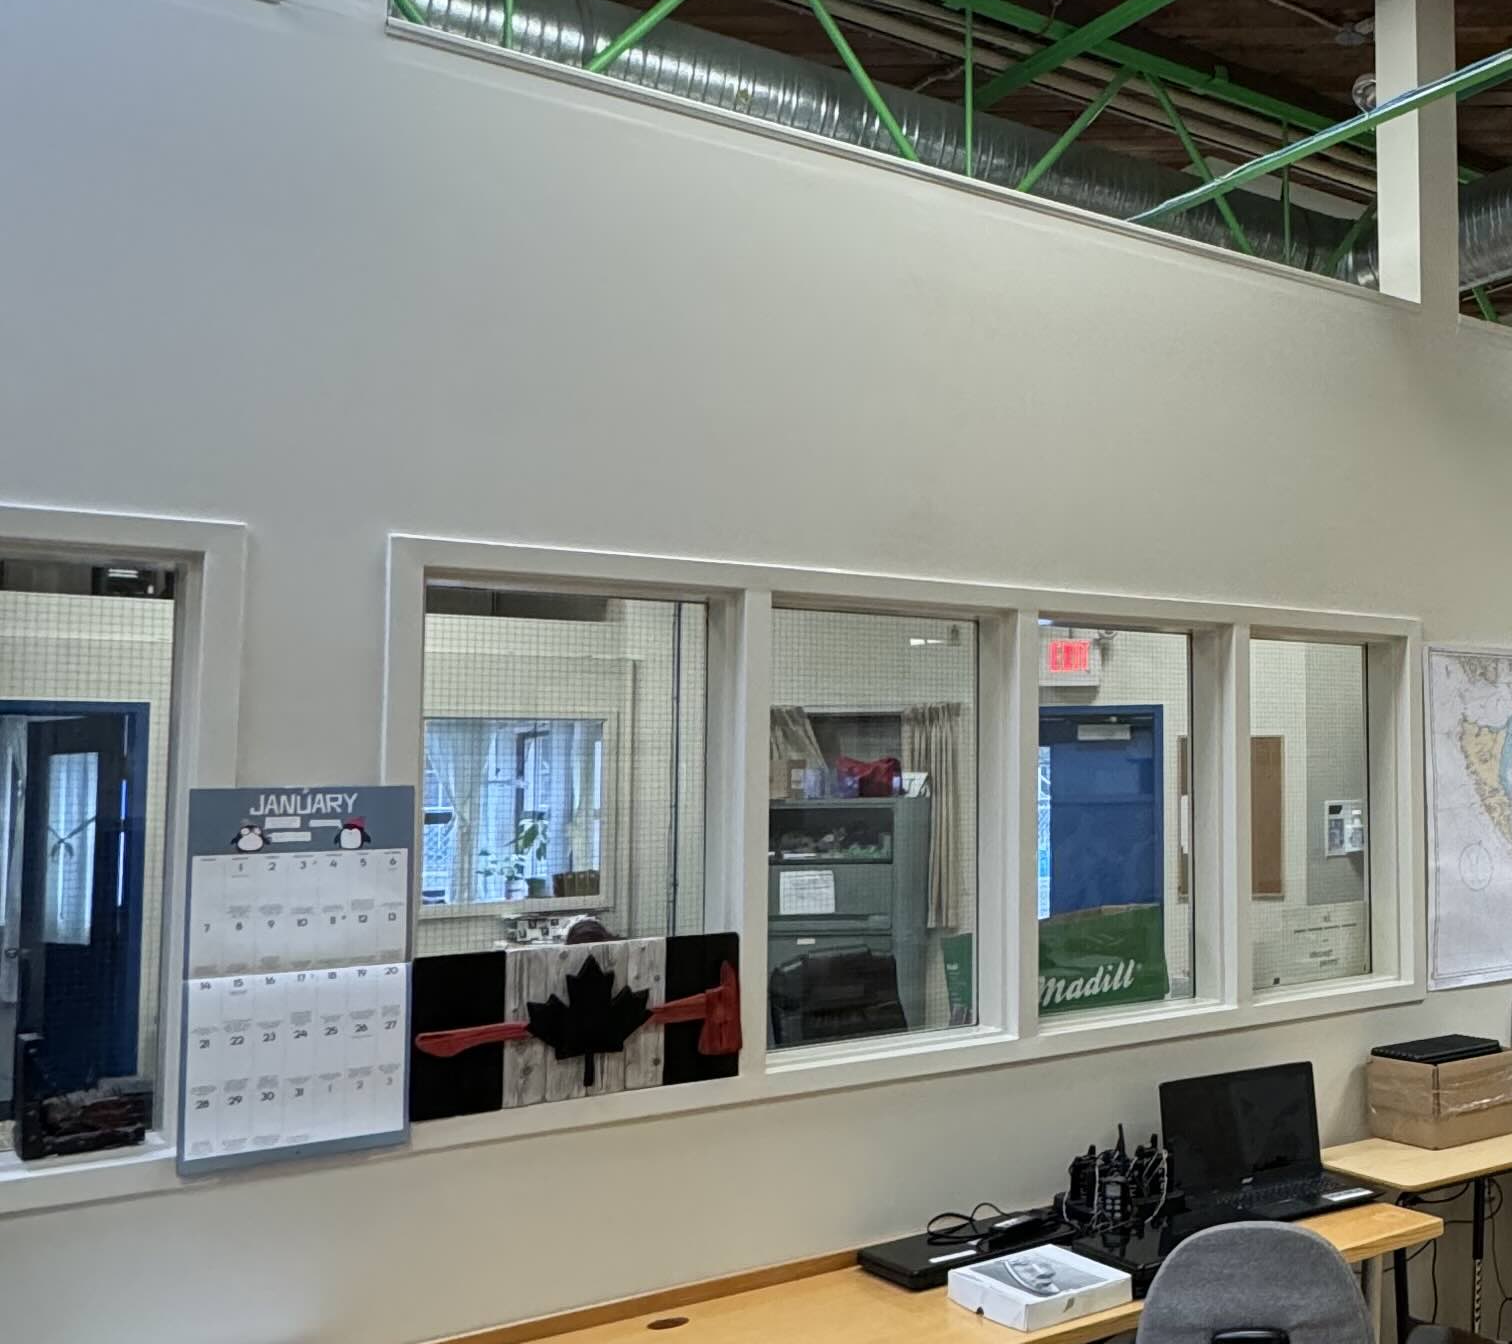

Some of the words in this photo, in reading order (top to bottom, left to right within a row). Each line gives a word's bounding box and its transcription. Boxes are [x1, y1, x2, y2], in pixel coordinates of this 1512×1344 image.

[249, 792, 358, 816] JANUARY
[297, 918, 308, 928] 10
[265, 976, 276, 985] 16
[297, 974, 306, 983] 17
[384, 966, 399, 975] 20
[1039, 958, 1135, 1007] Madill
[229, 1036, 245, 1046] 22
[263, 1032, 277, 1042] 23
[293, 1029, 308, 1039] 24
[324, 1027, 338, 1036] 25
[354, 1023, 368, 1033] 26
[384, 1020, 398, 1030] 27
[195, 1099, 210, 1110] 28
[228, 1095, 243, 1106] 29
[260, 1091, 275, 1101] 30
